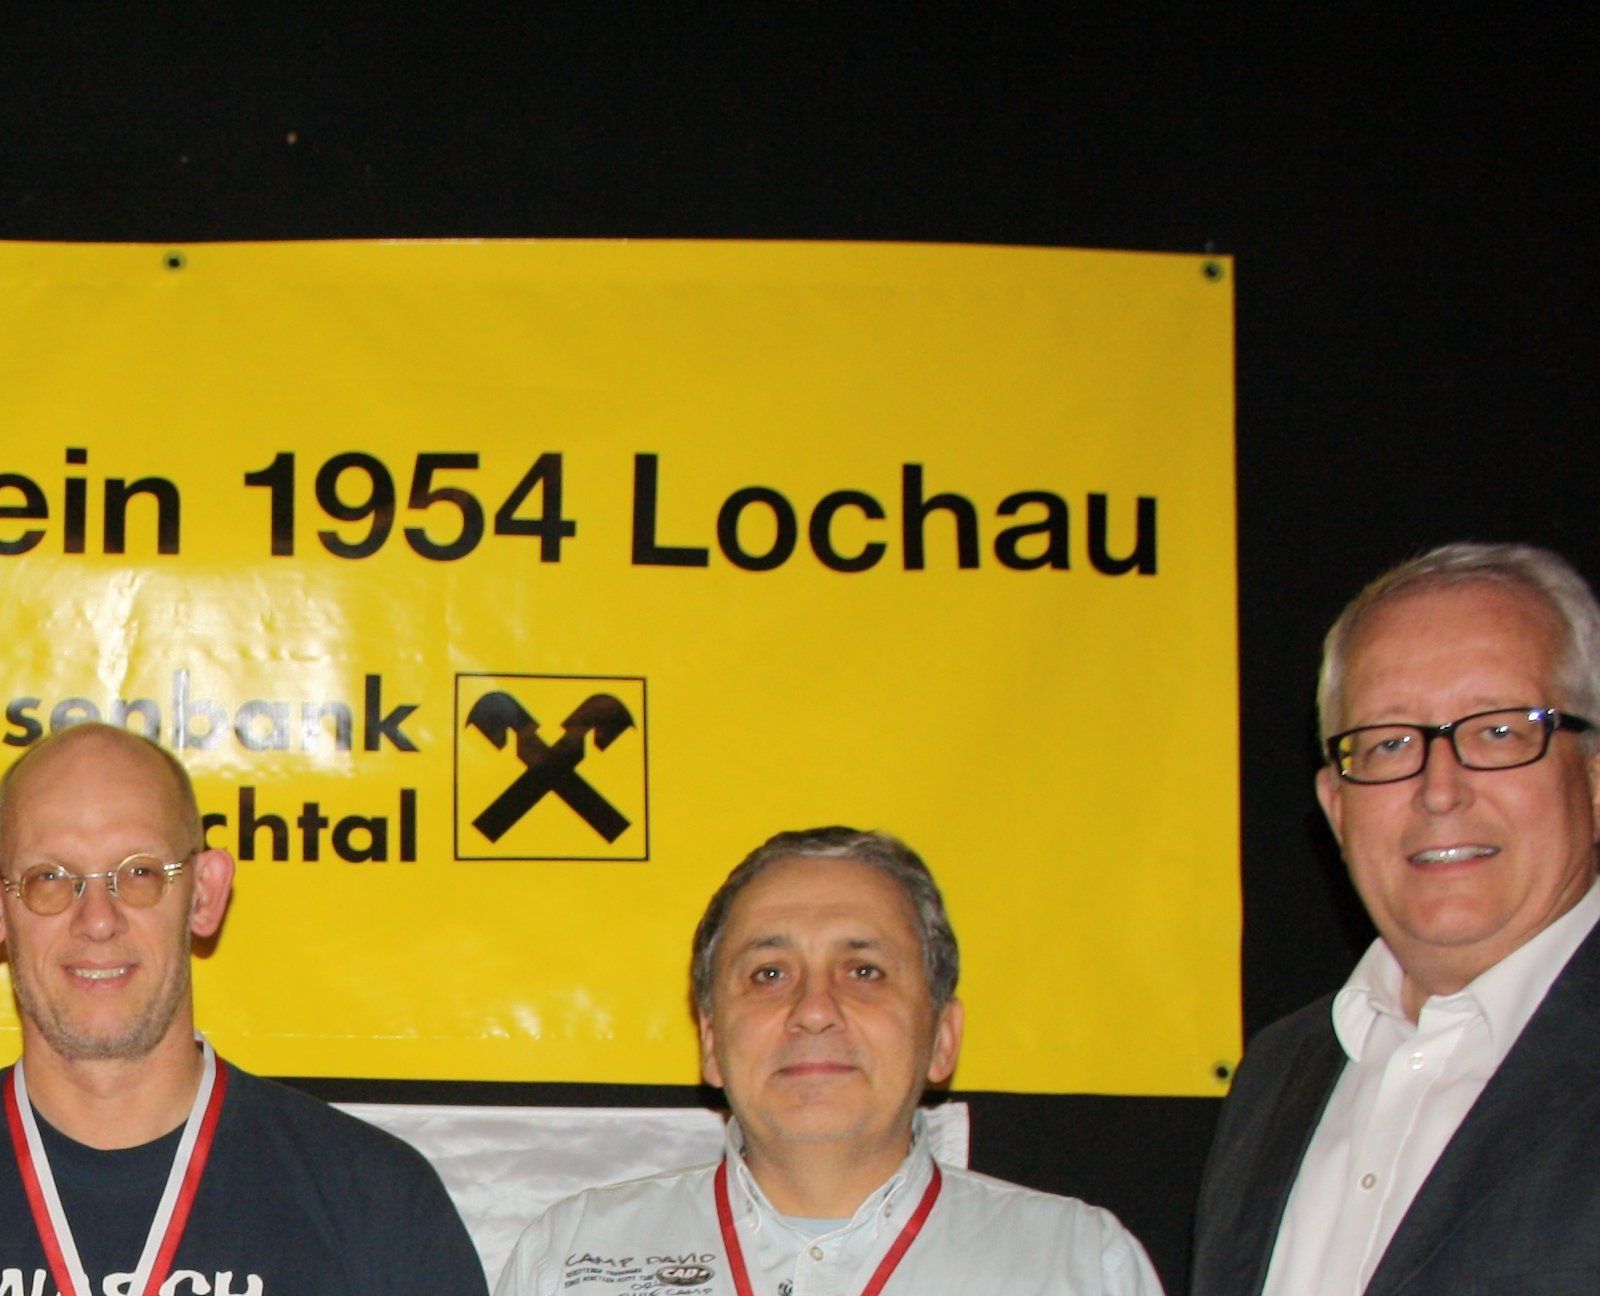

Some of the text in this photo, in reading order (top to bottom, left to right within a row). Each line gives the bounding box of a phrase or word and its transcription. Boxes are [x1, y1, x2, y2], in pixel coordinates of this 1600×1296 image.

[243, 450, 576, 563] 1954
[631, 452, 1158, 577] Lochau
[565, 1252, 717, 1268] CAMP DAVID
